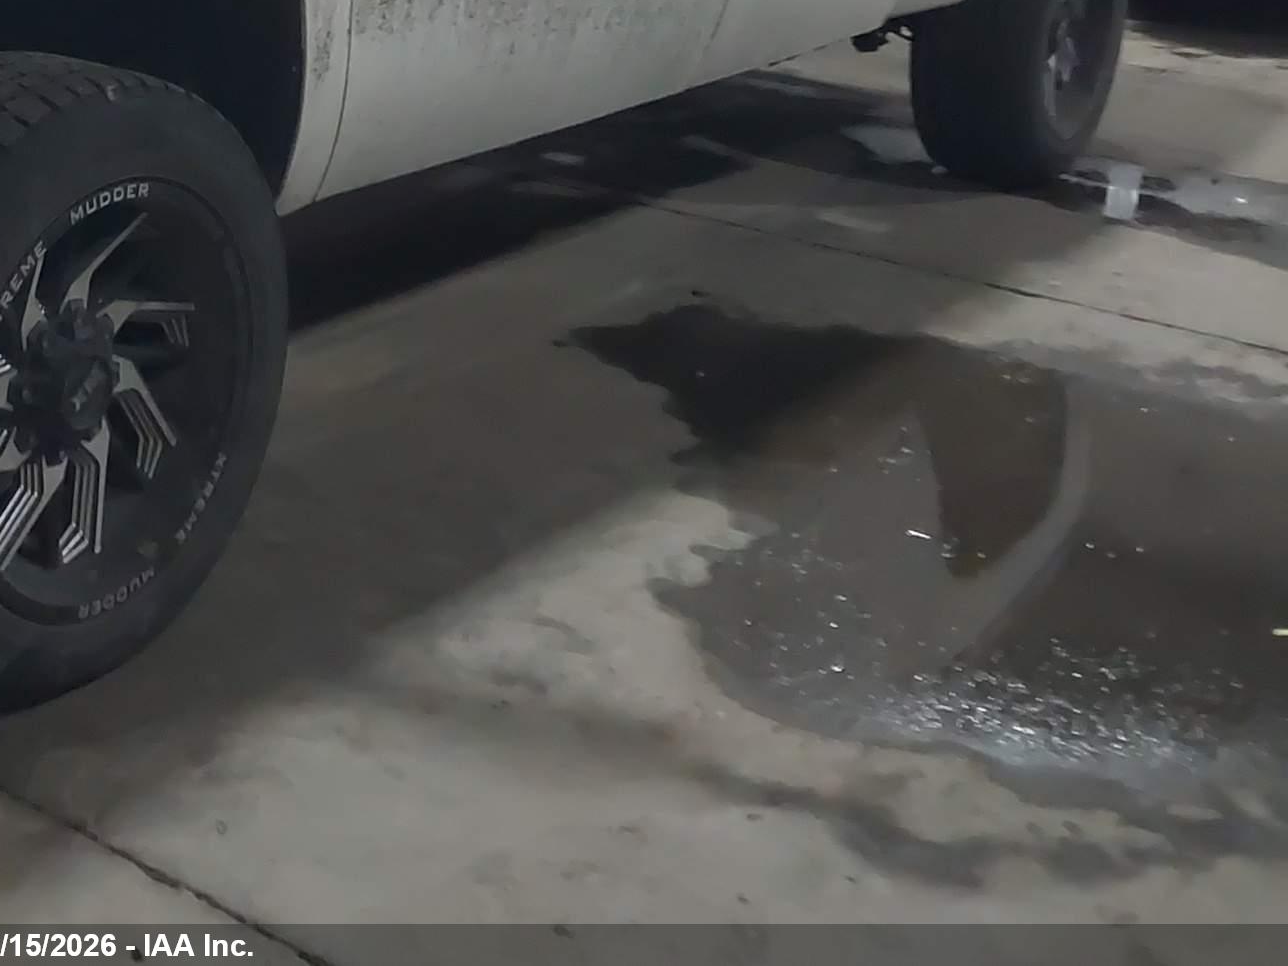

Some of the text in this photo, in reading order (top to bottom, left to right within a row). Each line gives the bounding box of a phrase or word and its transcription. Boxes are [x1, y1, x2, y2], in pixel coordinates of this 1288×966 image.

[69, 182, 150, 225] MUDDER
[77, 451, 227, 619] XTREME MUDDER
